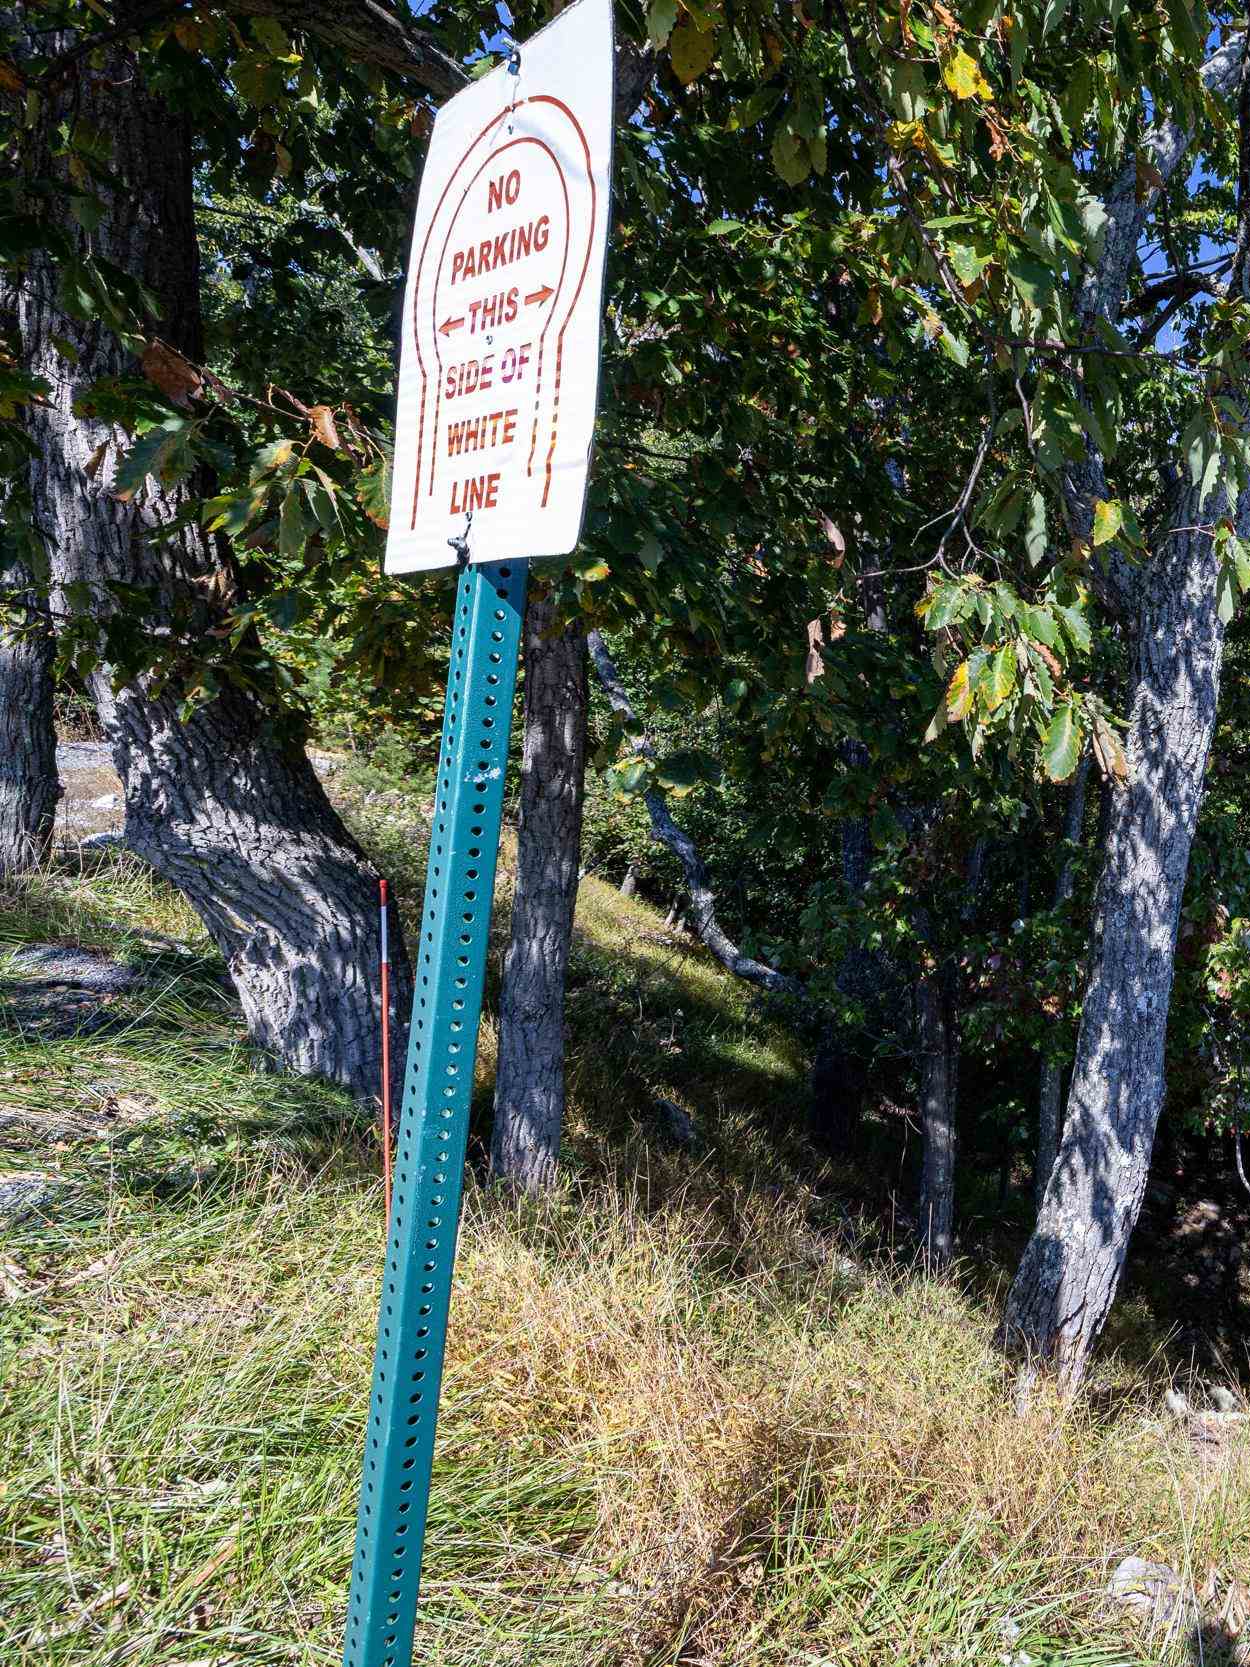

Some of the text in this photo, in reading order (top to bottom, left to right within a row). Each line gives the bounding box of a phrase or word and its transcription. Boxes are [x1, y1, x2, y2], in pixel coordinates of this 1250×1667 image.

[488, 169, 521, 214] NO
[451, 215, 550, 285] PARKING
[469, 287, 520, 334] THIS
[445, 343, 532, 400] SIDE OF
[447, 409, 518, 457] WHITE
[450, 473, 501, 515] LINE
